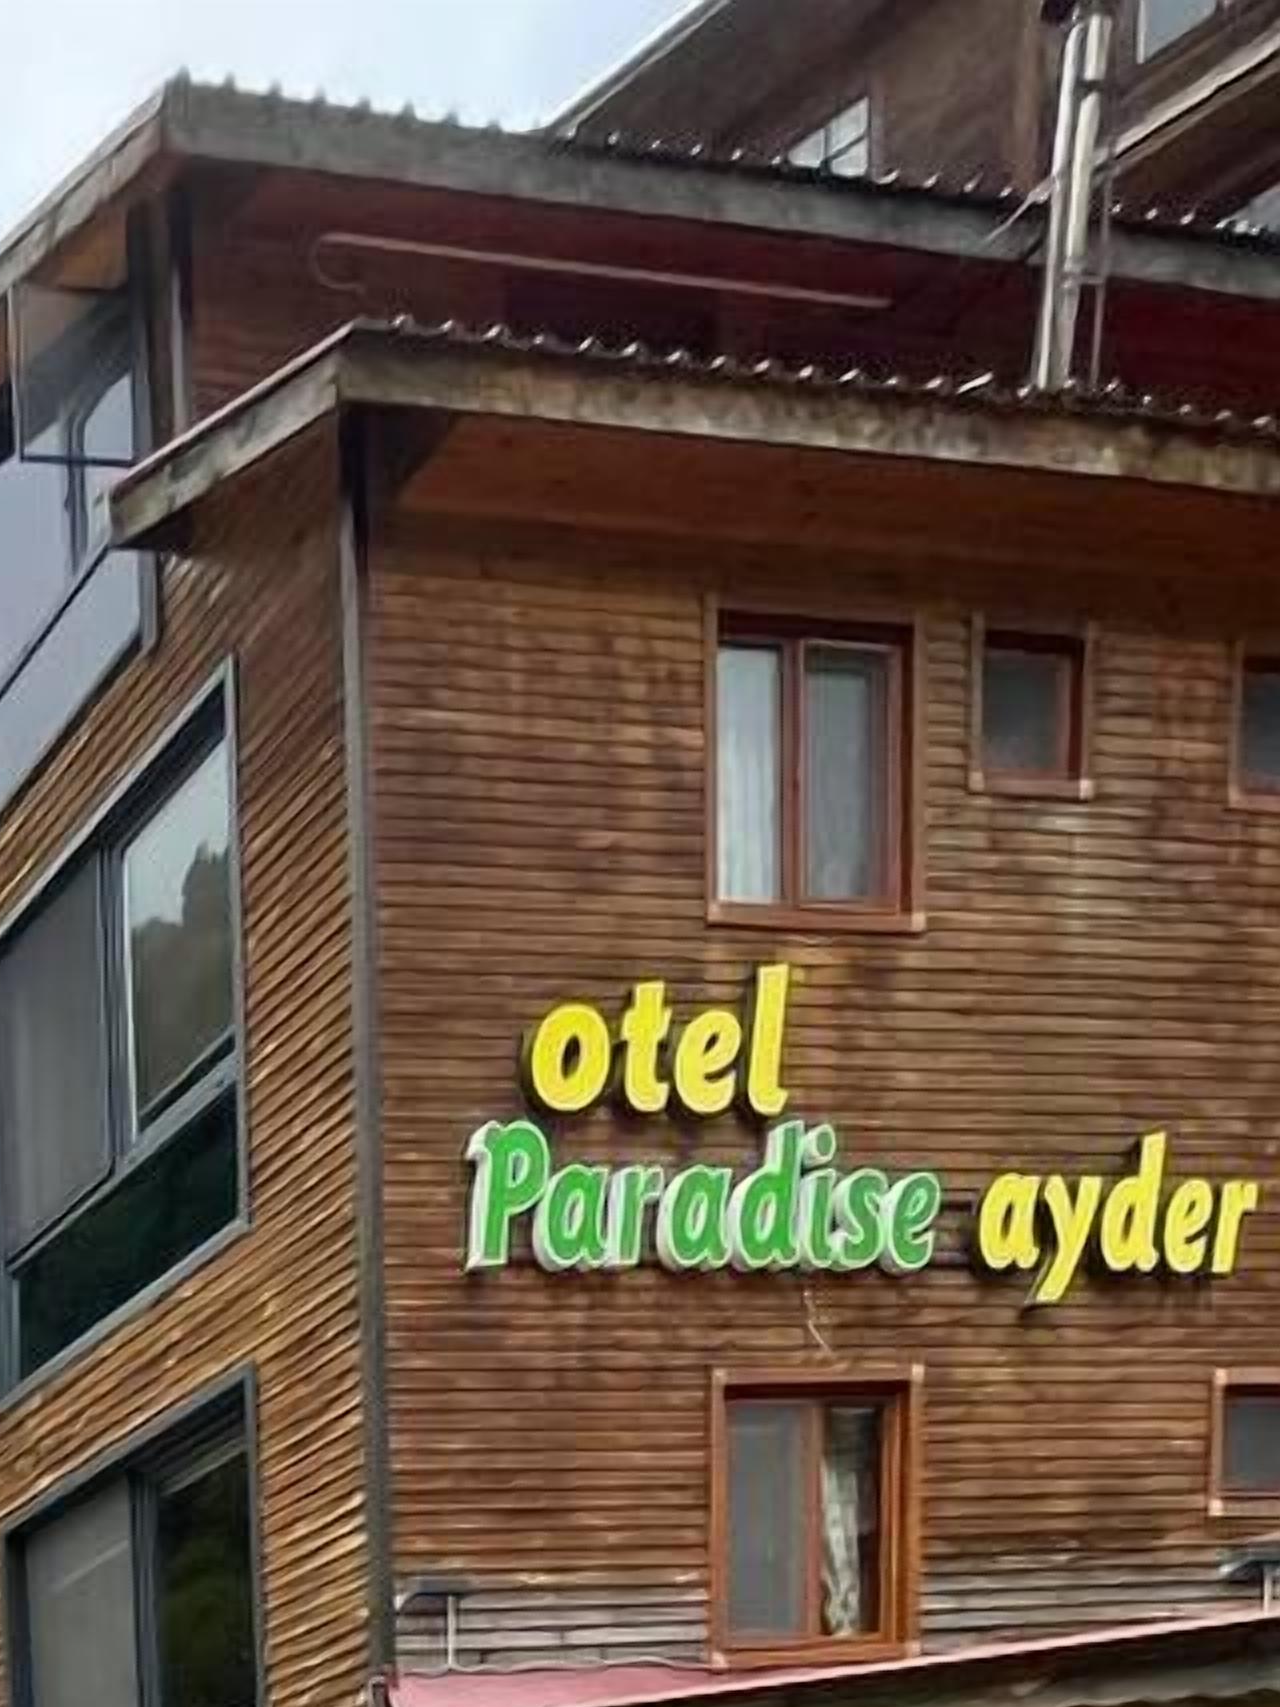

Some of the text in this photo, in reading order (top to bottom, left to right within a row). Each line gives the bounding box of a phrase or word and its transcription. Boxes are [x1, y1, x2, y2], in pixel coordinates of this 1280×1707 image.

[529, 963, 791, 1115] otel
[464, 1119, 1260, 1304] Paradise ayder
